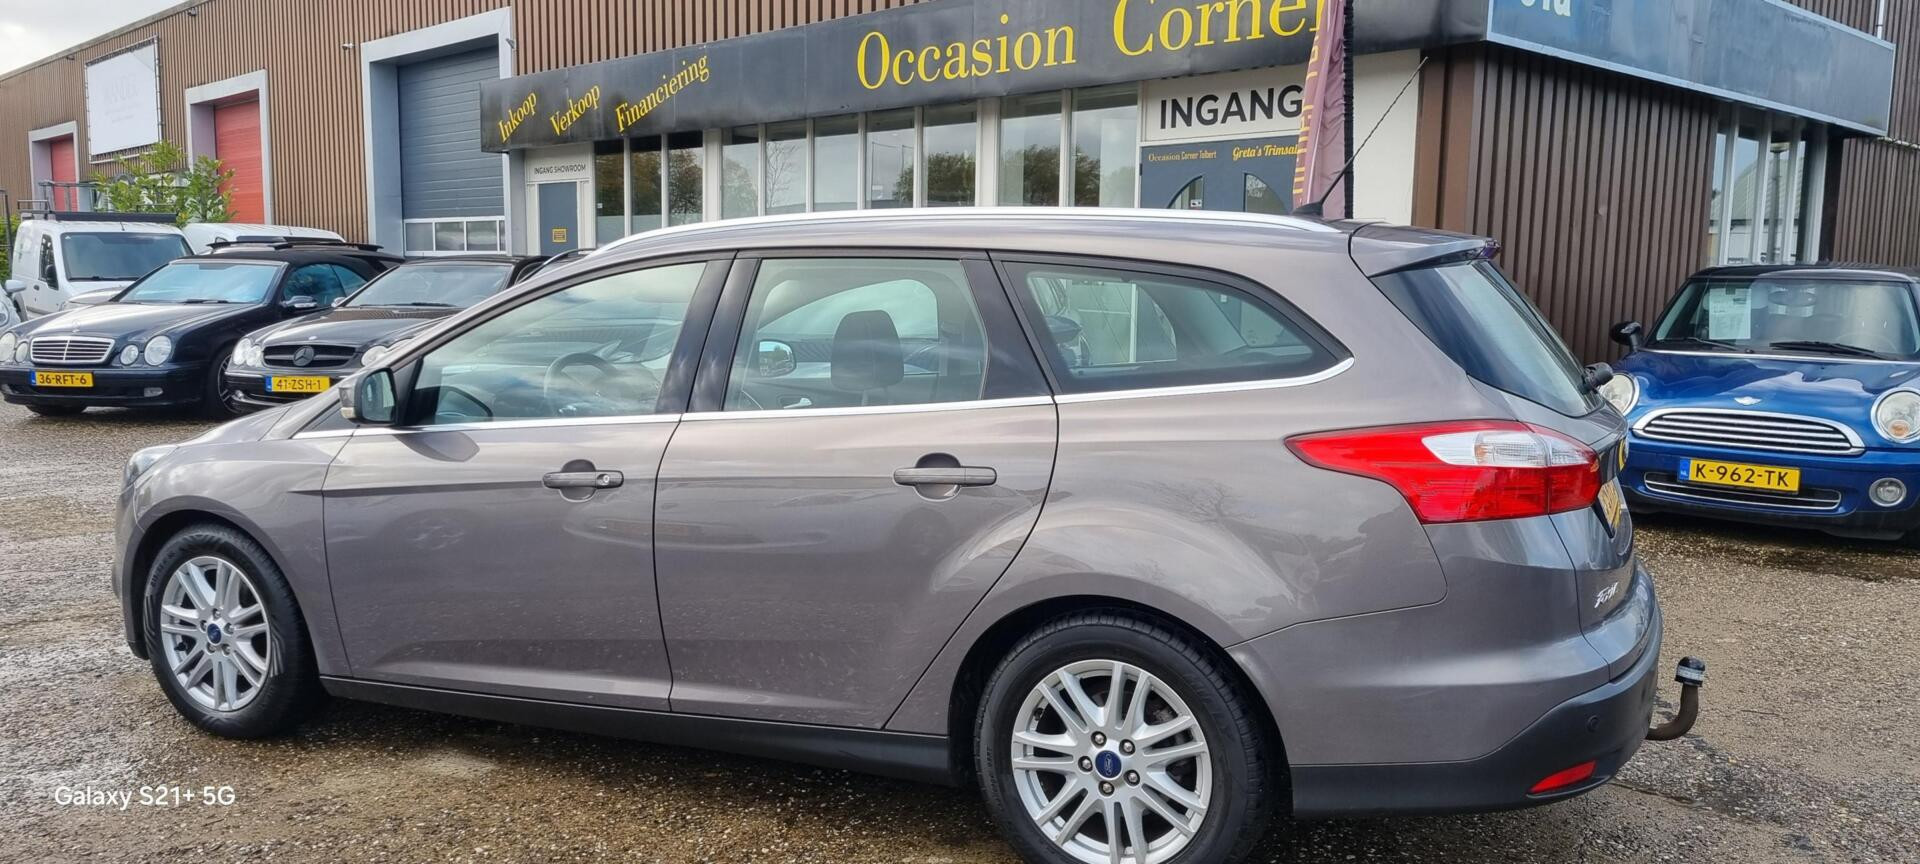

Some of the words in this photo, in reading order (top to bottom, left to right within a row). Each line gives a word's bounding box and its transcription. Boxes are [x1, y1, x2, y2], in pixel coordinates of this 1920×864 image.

[857, 14, 1077, 90] Occasion
[615, 56, 710, 132] Financiering
[498, 91, 537, 143] Inkoop
[550, 85, 600, 136] Verkoop
[1160, 85, 1303, 129] INGANG
[1148, 152, 1181, 161] Occasion
[1232, 145, 1262, 160] Greta's
[534, 166, 554, 174] INGANG
[554, 164, 586, 174] SHOWROOM
[39, 374, 87, 385] 36-RFT-6
[276, 379, 321, 391] 41-ZSH-1
[1695, 463, 1790, 487] K-962-TK
